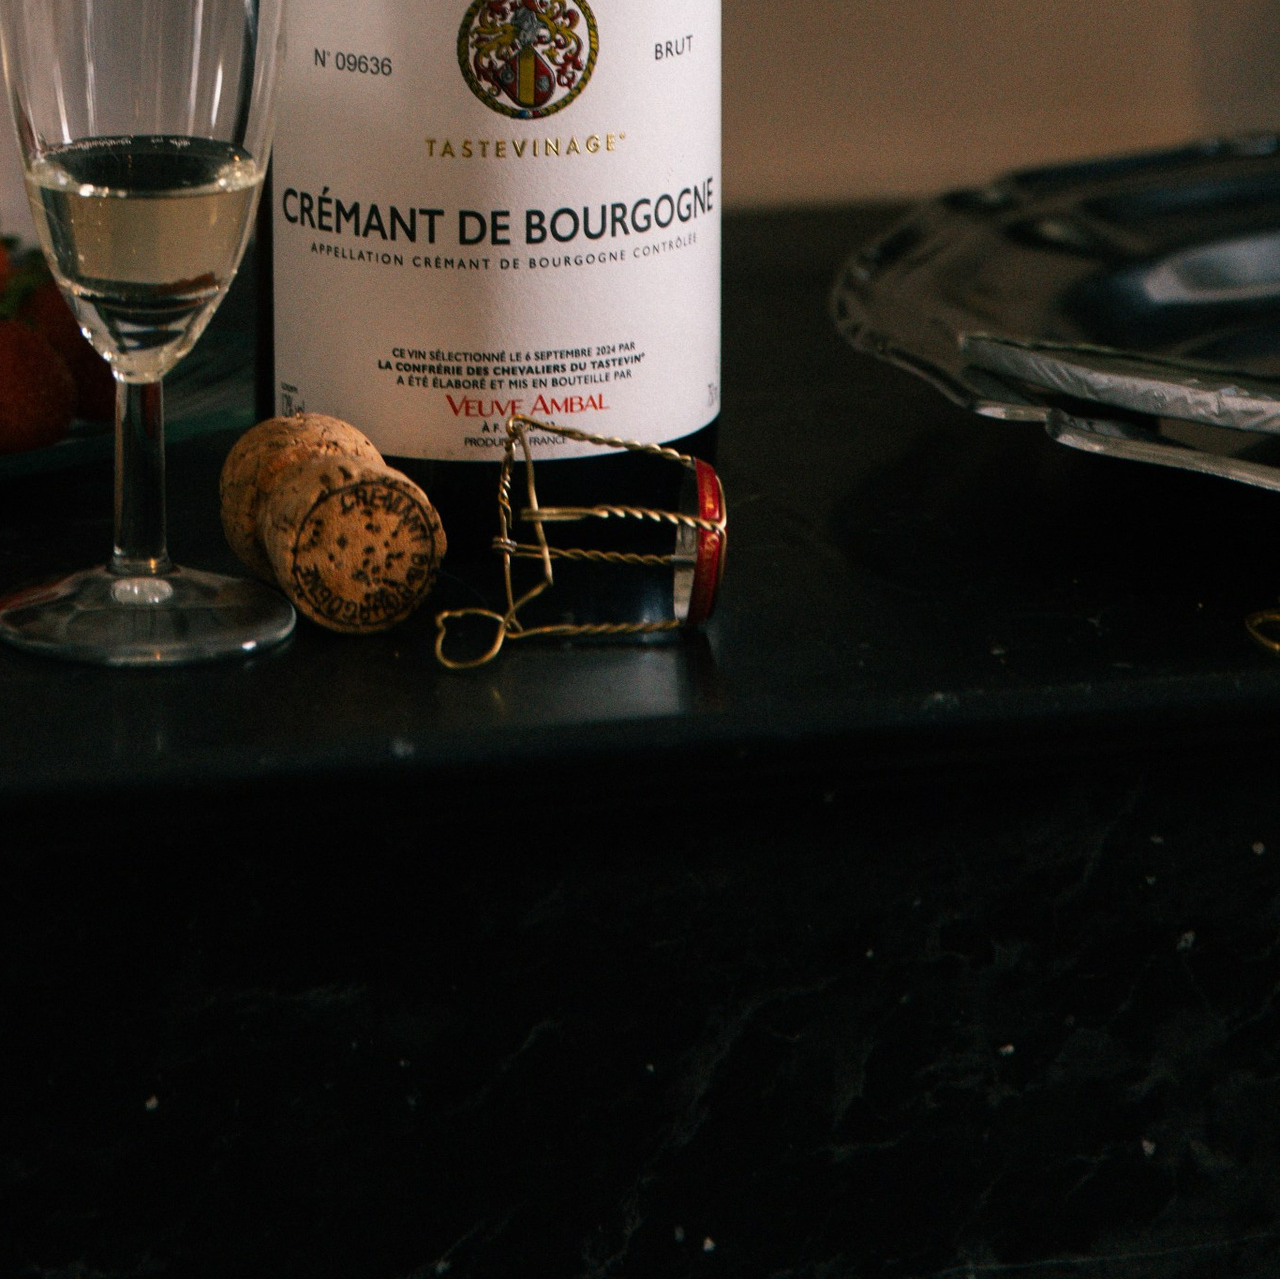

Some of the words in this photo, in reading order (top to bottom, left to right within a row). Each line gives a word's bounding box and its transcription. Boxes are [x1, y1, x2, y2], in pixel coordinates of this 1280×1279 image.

[654, 35, 694, 60] BRUT
[335, 51, 393, 76] 09636
[282, 186, 445, 244] CRÉMANT
[458, 209, 511, 246] DE
[525, 177, 714, 244] BOURGOGNE
[310, 241, 404, 266] APPELLATION
[500, 258, 520, 270] DE
[528, 250, 626, 269] BOURGOGNE
[391, 347, 406, 358] CE
[407, 348, 426, 360] VIN
[429, 349, 506, 363] SÉLECTIONNÉ
[509, 351, 521, 362] LE
[524, 351, 531, 361] 6
[534, 347, 592, 361] SEPTEMBRE
[595, 345, 616, 356] 2024
[618, 341, 636, 352] PAR
[377, 359, 393, 370] LA
[395, 362, 463, 376] CONFRÉRIE
[466, 366, 489, 376] DES
[493, 363, 567, 376] CHEVALIERS
[570, 362, 587, 372] DU
[396, 375, 405, 385] A
[408, 374, 428, 388] ÉTÉ
[432, 376, 486, 390] ÉLABORÉ
[490, 379, 505, 390] ET
[509, 378, 528, 390] MIS
[532, 378, 548, 389] EN
[551, 372, 611, 388] BOUTEILLE
[613, 369, 633, 380] PAR
[445, 394, 523, 417] VEUVE
[530, 393, 610, 416] AMBAL
